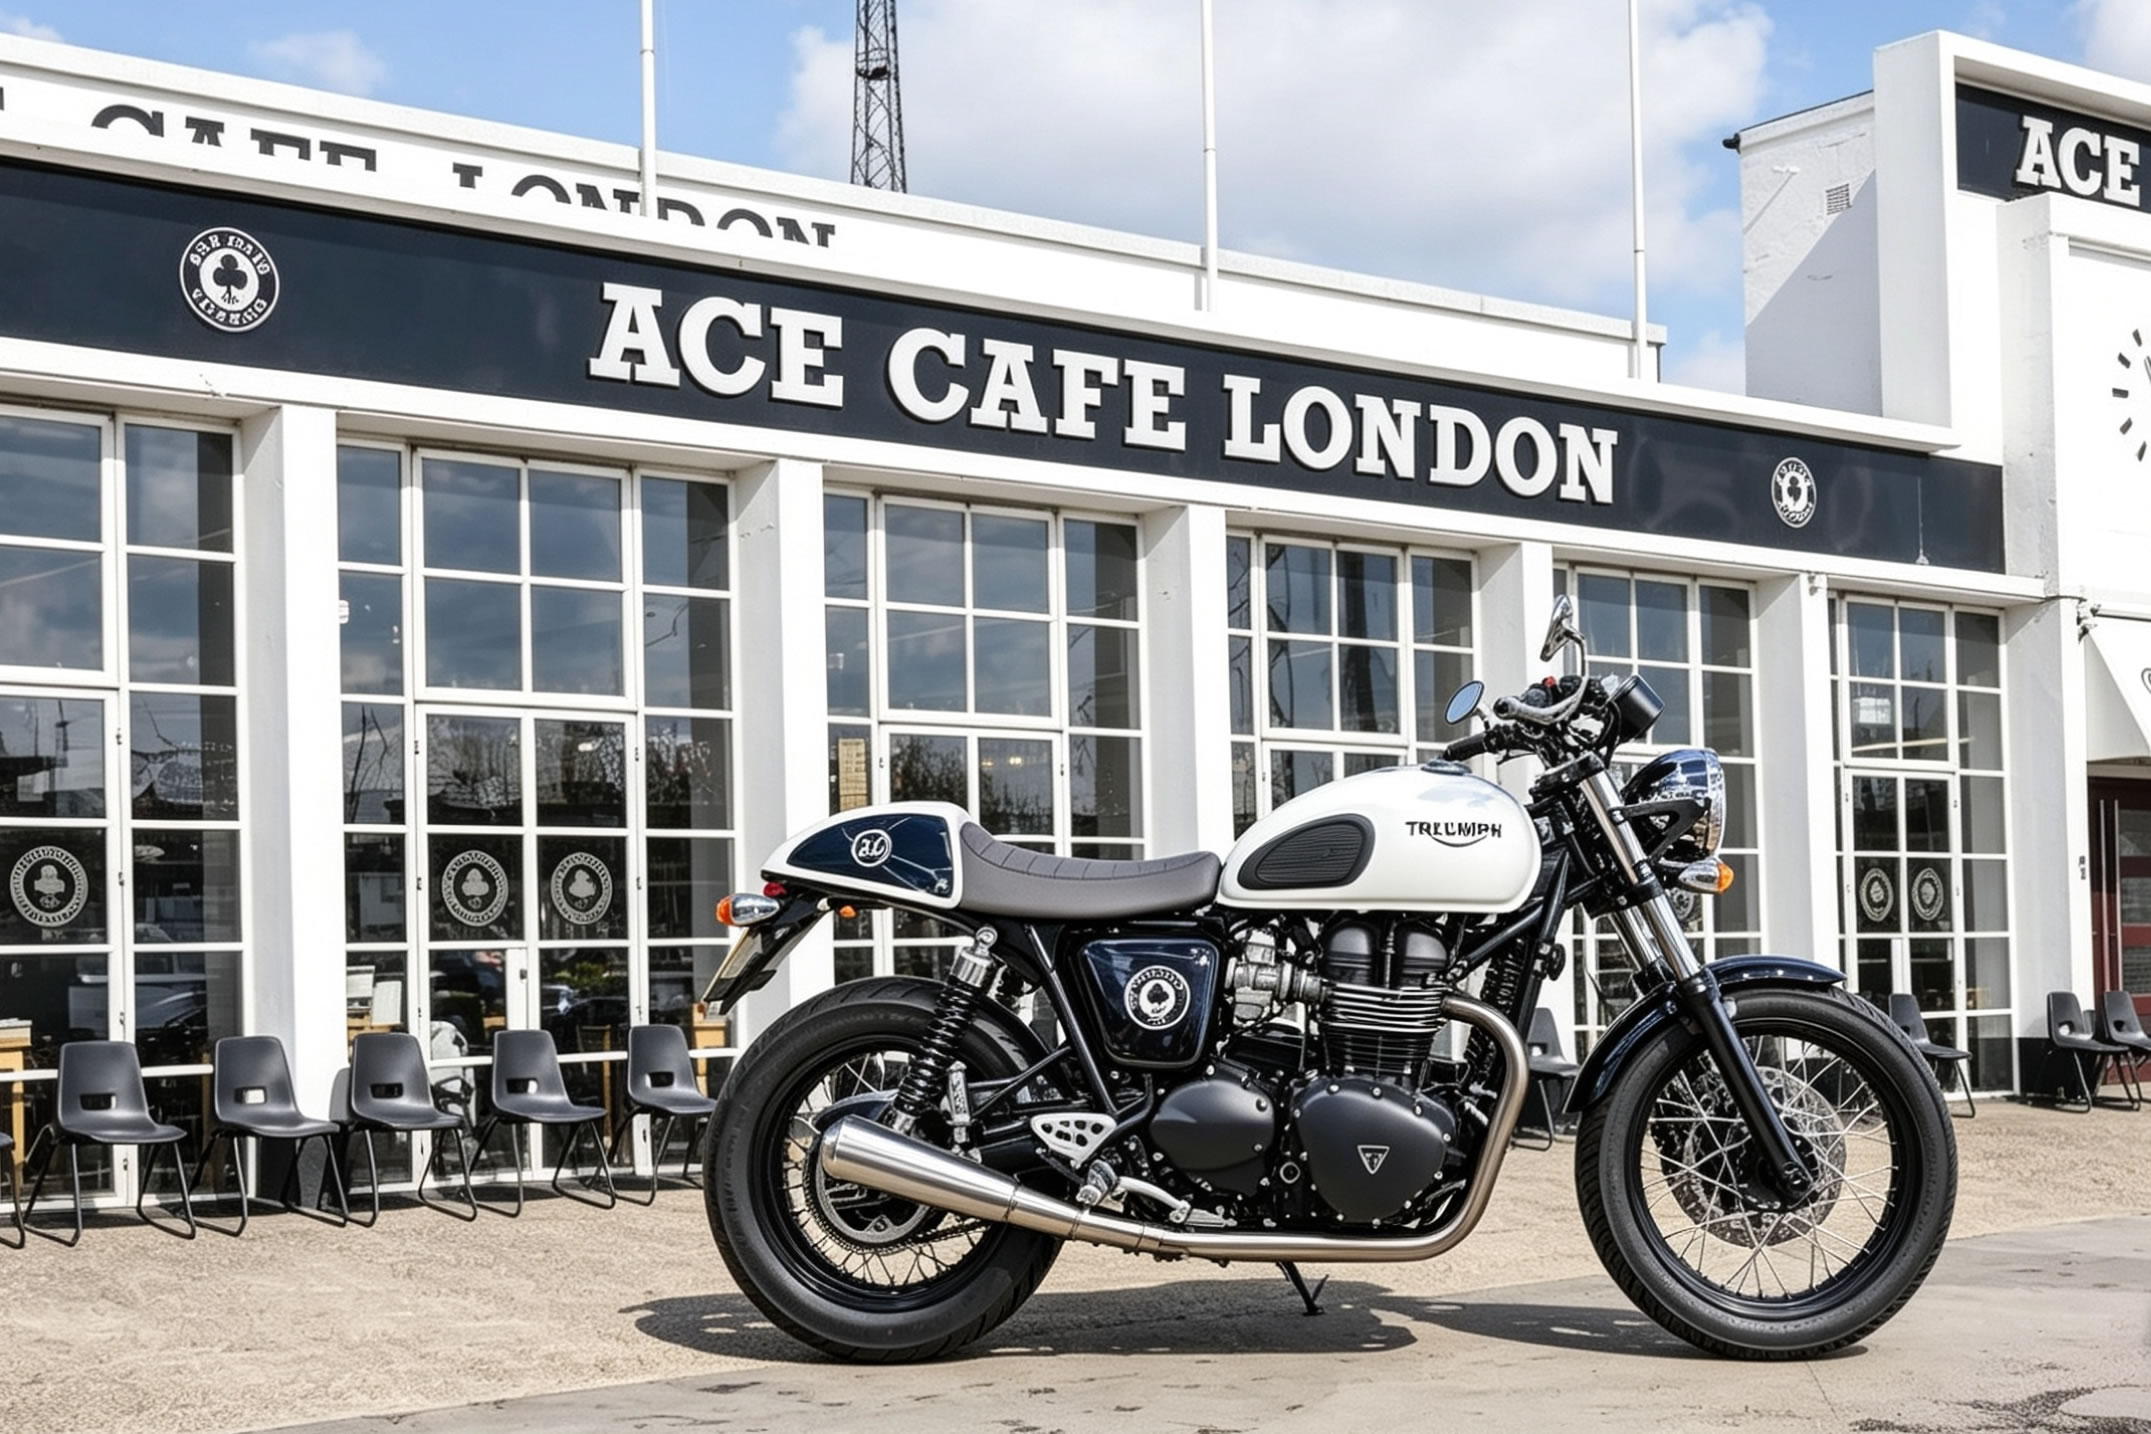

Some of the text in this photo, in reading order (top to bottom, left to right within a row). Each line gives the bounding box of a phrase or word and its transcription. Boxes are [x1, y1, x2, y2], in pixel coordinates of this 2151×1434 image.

[2016, 115, 2141, 207] ACE
[589, 282, 1618, 504] ACE CAFE LONDON
